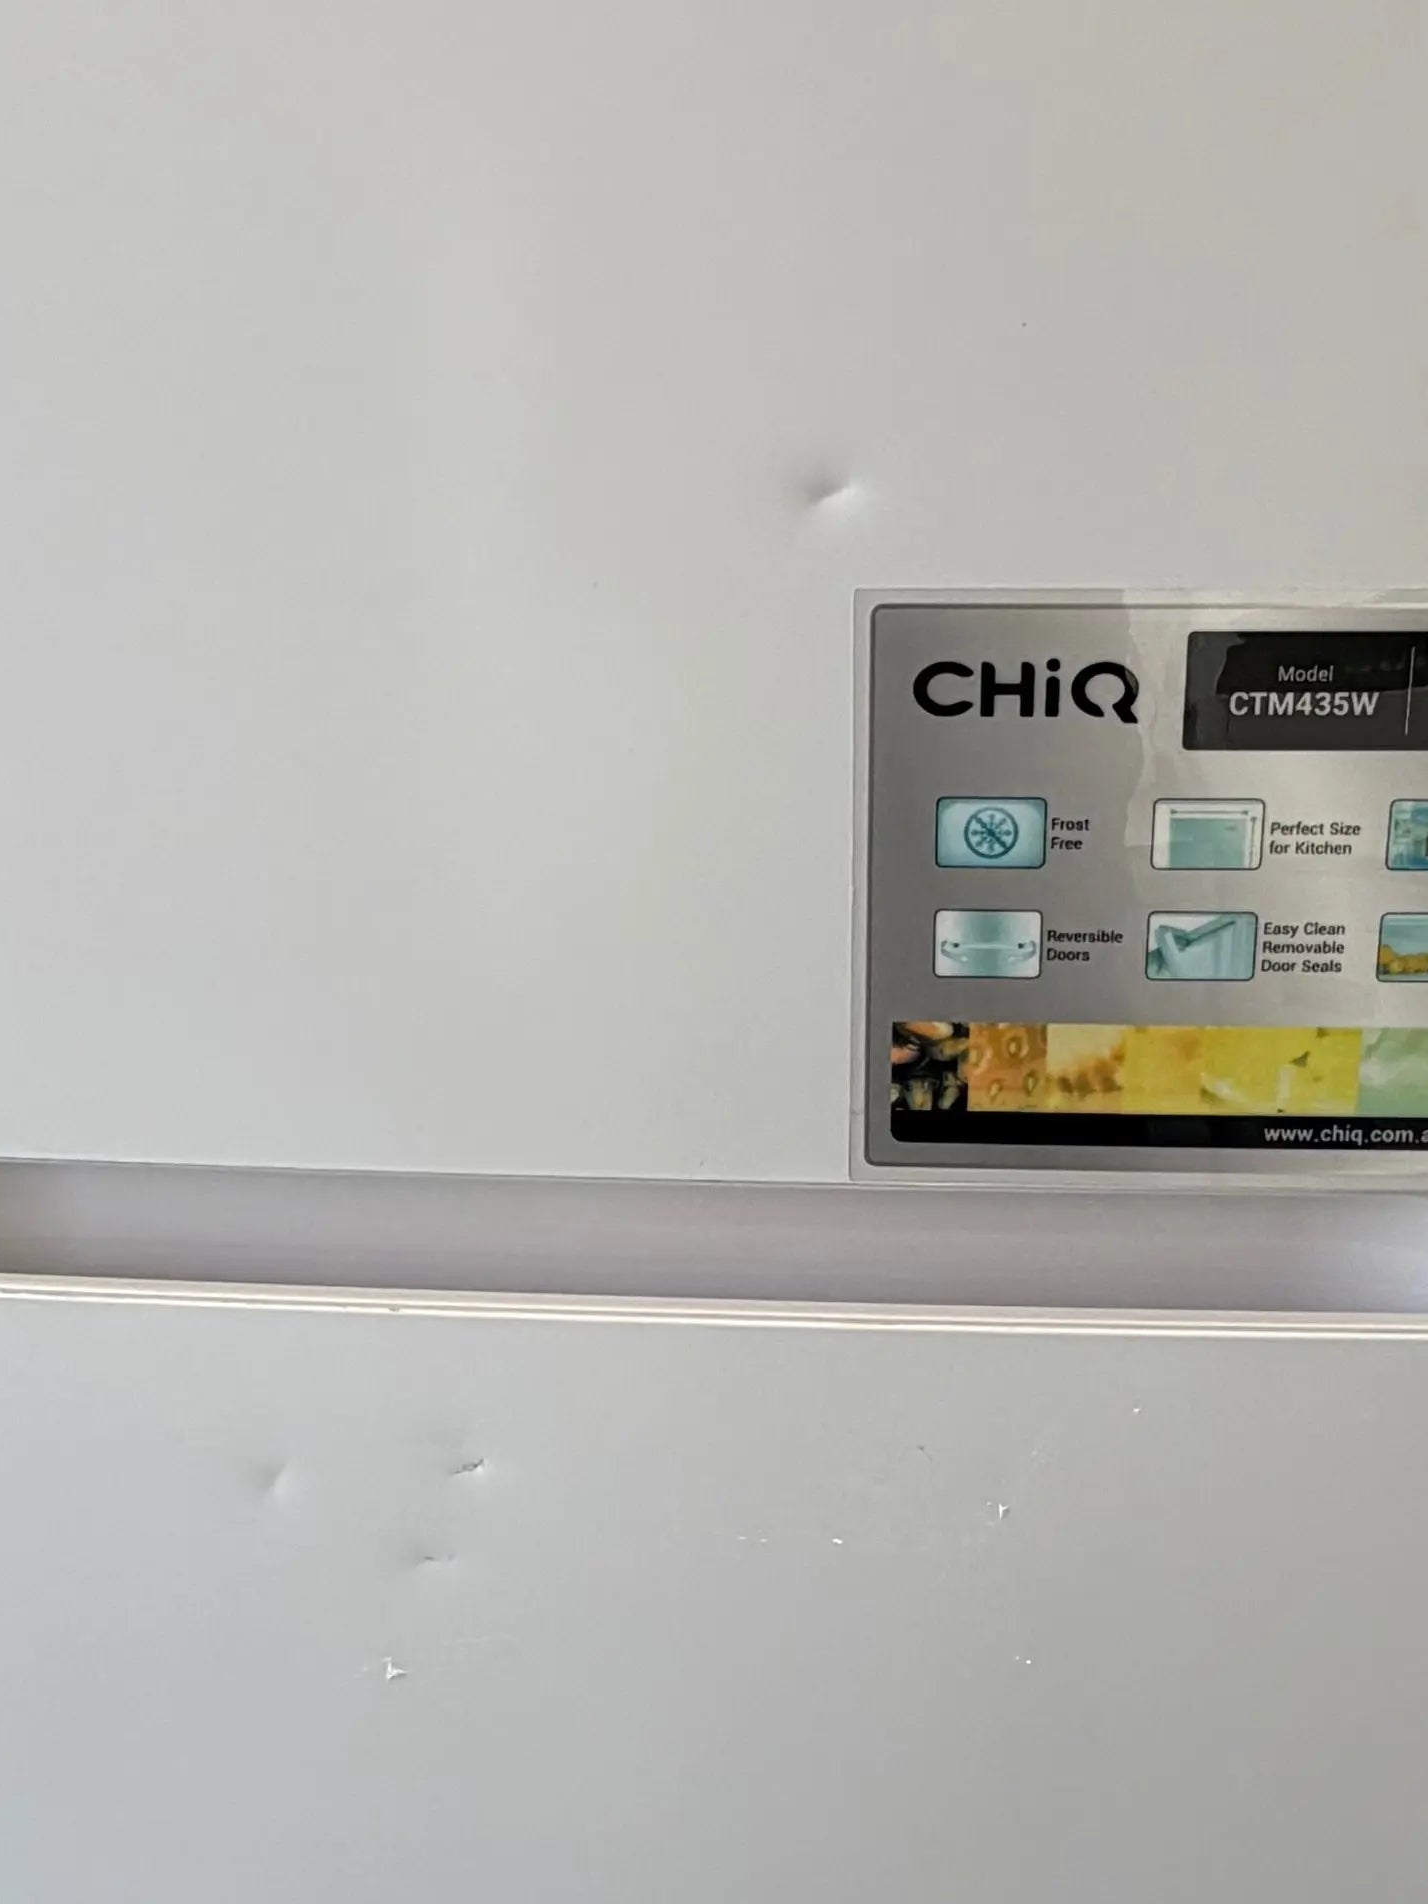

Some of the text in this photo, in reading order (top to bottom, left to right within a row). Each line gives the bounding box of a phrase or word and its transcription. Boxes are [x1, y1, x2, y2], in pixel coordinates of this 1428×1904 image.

[1277, 665, 1334, 682] Model
[912, 657, 1140, 725] CHiQ
[1228, 690, 1381, 717] CTM435W
[1050, 817, 1090, 832] Frost
[1269, 821, 1362, 836] Perfect Size
[1050, 836, 1083, 851] Free
[1268, 840, 1353, 856] for Kitchen
[1046, 929, 1124, 944] Reversible
[1262, 921, 1346, 939] Easy Clean
[1261, 940, 1346, 955] Removable
[1046, 948, 1090, 963] Doors
[1260, 958, 1343, 974] Door Seals
